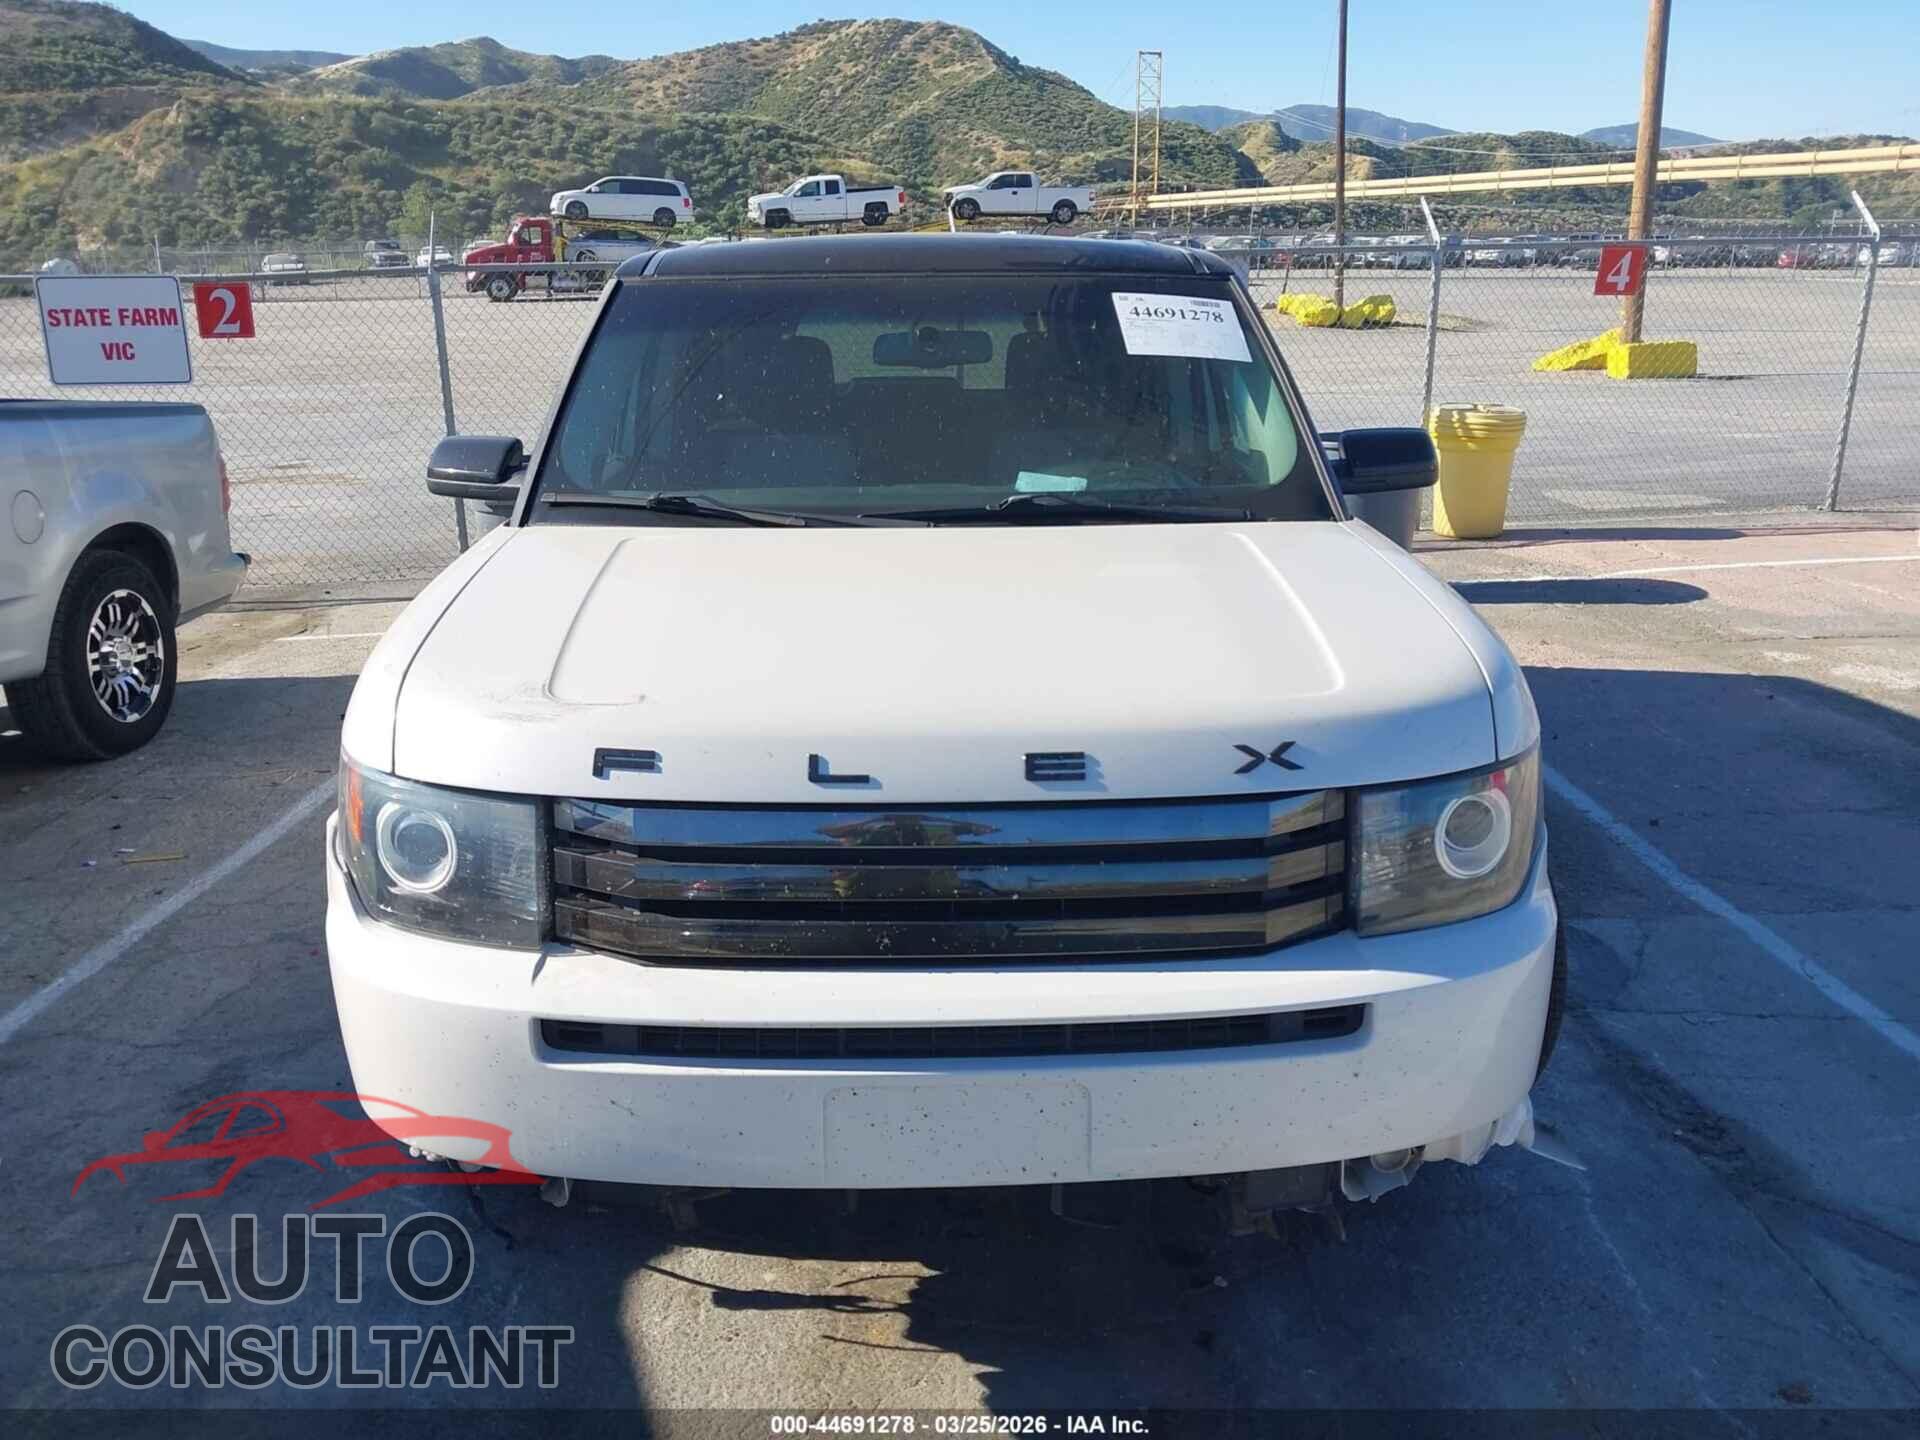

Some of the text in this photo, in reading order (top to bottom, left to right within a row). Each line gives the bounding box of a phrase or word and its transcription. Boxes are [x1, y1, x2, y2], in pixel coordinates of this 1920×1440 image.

[1606, 250, 1632, 291] 4
[47, 308, 179, 327] STATE FARM
[209, 288, 240, 334] 2
[1129, 305, 1224, 323] 44691278
[100, 342, 136, 361] VIC
[593, 741, 1304, 784] FLEX
